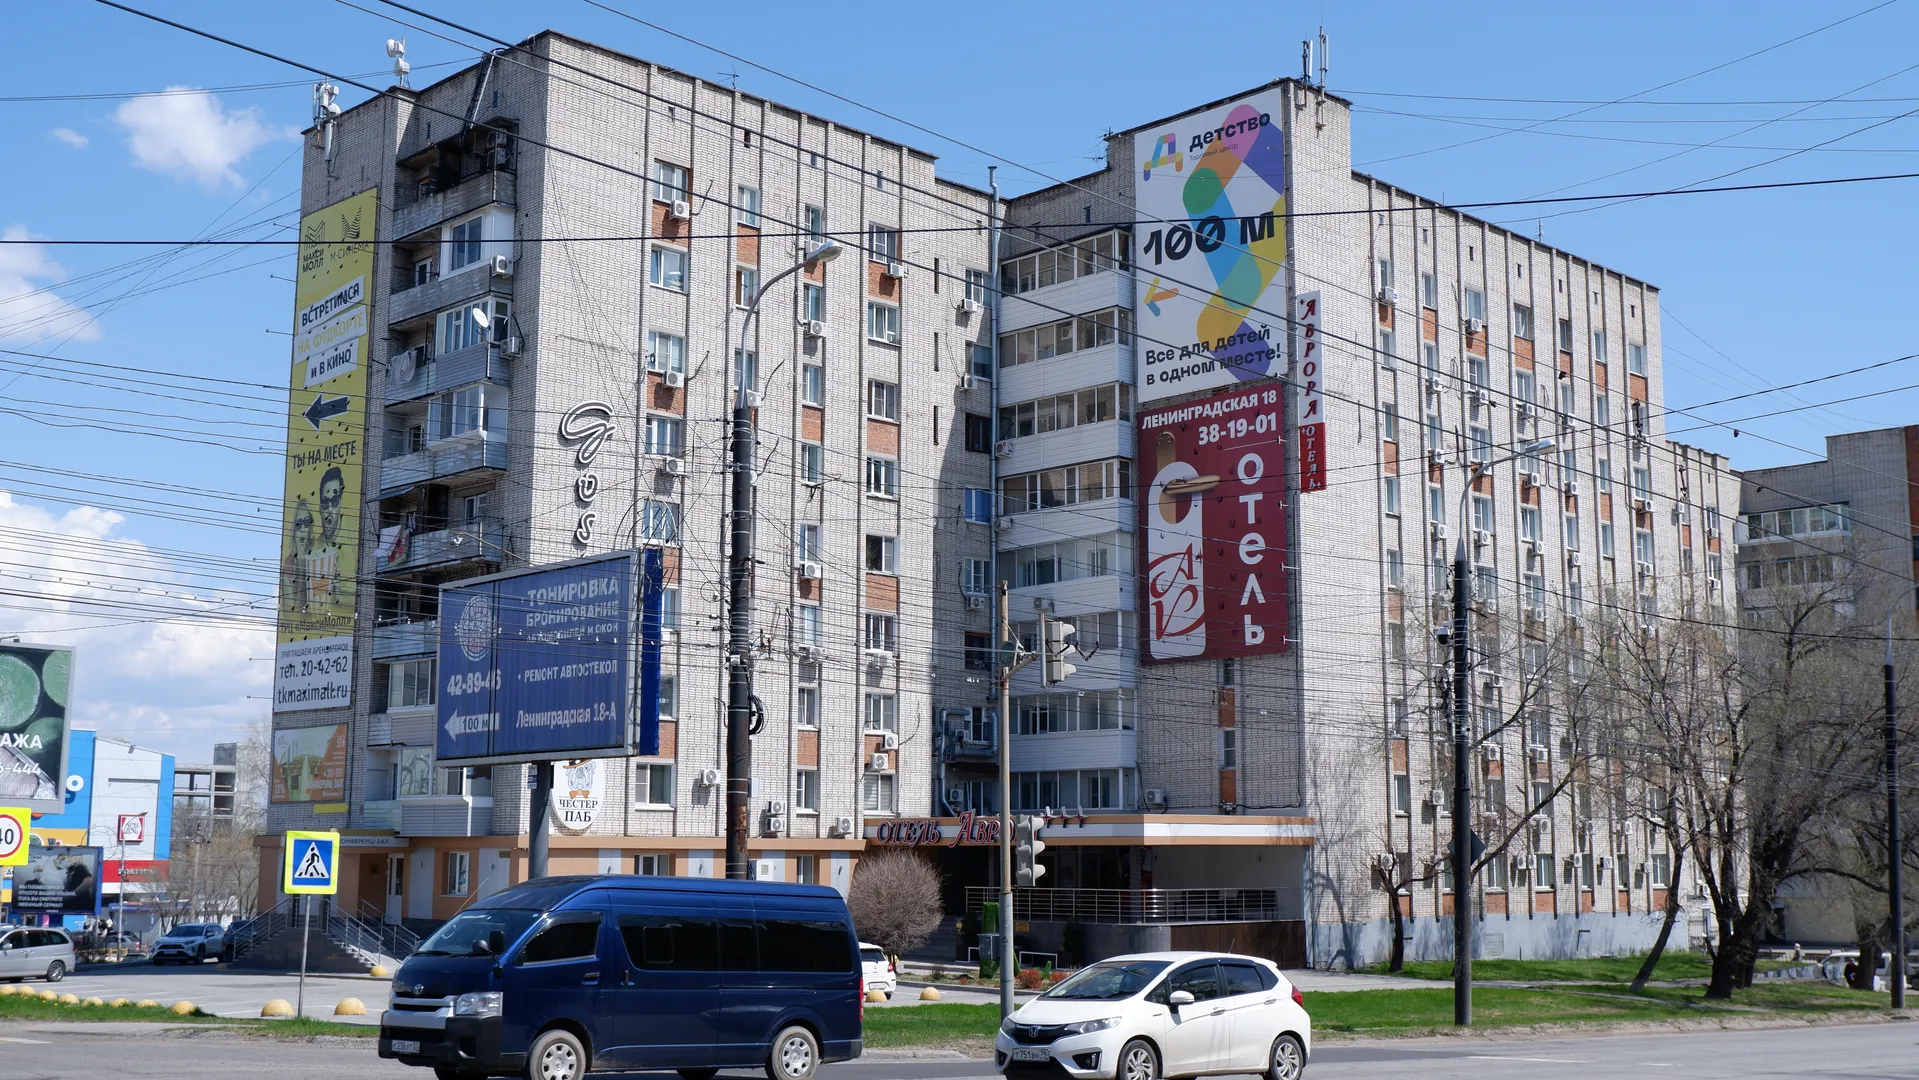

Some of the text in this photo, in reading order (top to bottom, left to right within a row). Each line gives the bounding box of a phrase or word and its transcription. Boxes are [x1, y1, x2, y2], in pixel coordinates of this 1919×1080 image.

[1189, 112, 1271, 153] детство
[1189, 143, 1239, 162] Торговый центр
[330, 240, 370, 262] М-СИНЕМА
[1143, 215, 1226, 266] 100
[302, 248, 324, 262] МАКСИ
[302, 258, 324, 273] МОЛЛ
[302, 283, 360, 327] ВСТРЕТИМСЯ
[298, 312, 364, 352] НА ФУДКОРТЕ
[1146, 324, 1270, 366] Все для детей
[326, 349, 352, 372] КИНО
[1146, 343, 1282, 386] в одном месте!
[1142, 390, 1277, 430] ЛЕНИНГРАДСКАЯ 18
[1198, 412, 1276, 446] 38-19-01
[292, 440, 356, 470] ТЫ НА МЕСТЕ
[528, 576, 618, 606] ТОНИРОВКА
[526, 600, 618, 627] БРОНИРОВАНИЕ
[596, 622, 618, 634] ОКОН
[280, 642, 348, 658] ПРИГЛАШАЕМ АРЕНДАТОРОВ
[280, 656, 348, 679] тел. 20-42-62
[524, 660, 618, 682] РЕМОНТ АВТОСТЕКОЛ
[462, 717, 479, 730] 100
[516, 702, 617, 729] Ленинградская 18-А
[559, 799, 598, 808] ЧЕСТЕР
[564, 811, 591, 822] ПАБ
[876, 820, 941, 848] ОТЕЛЬ
